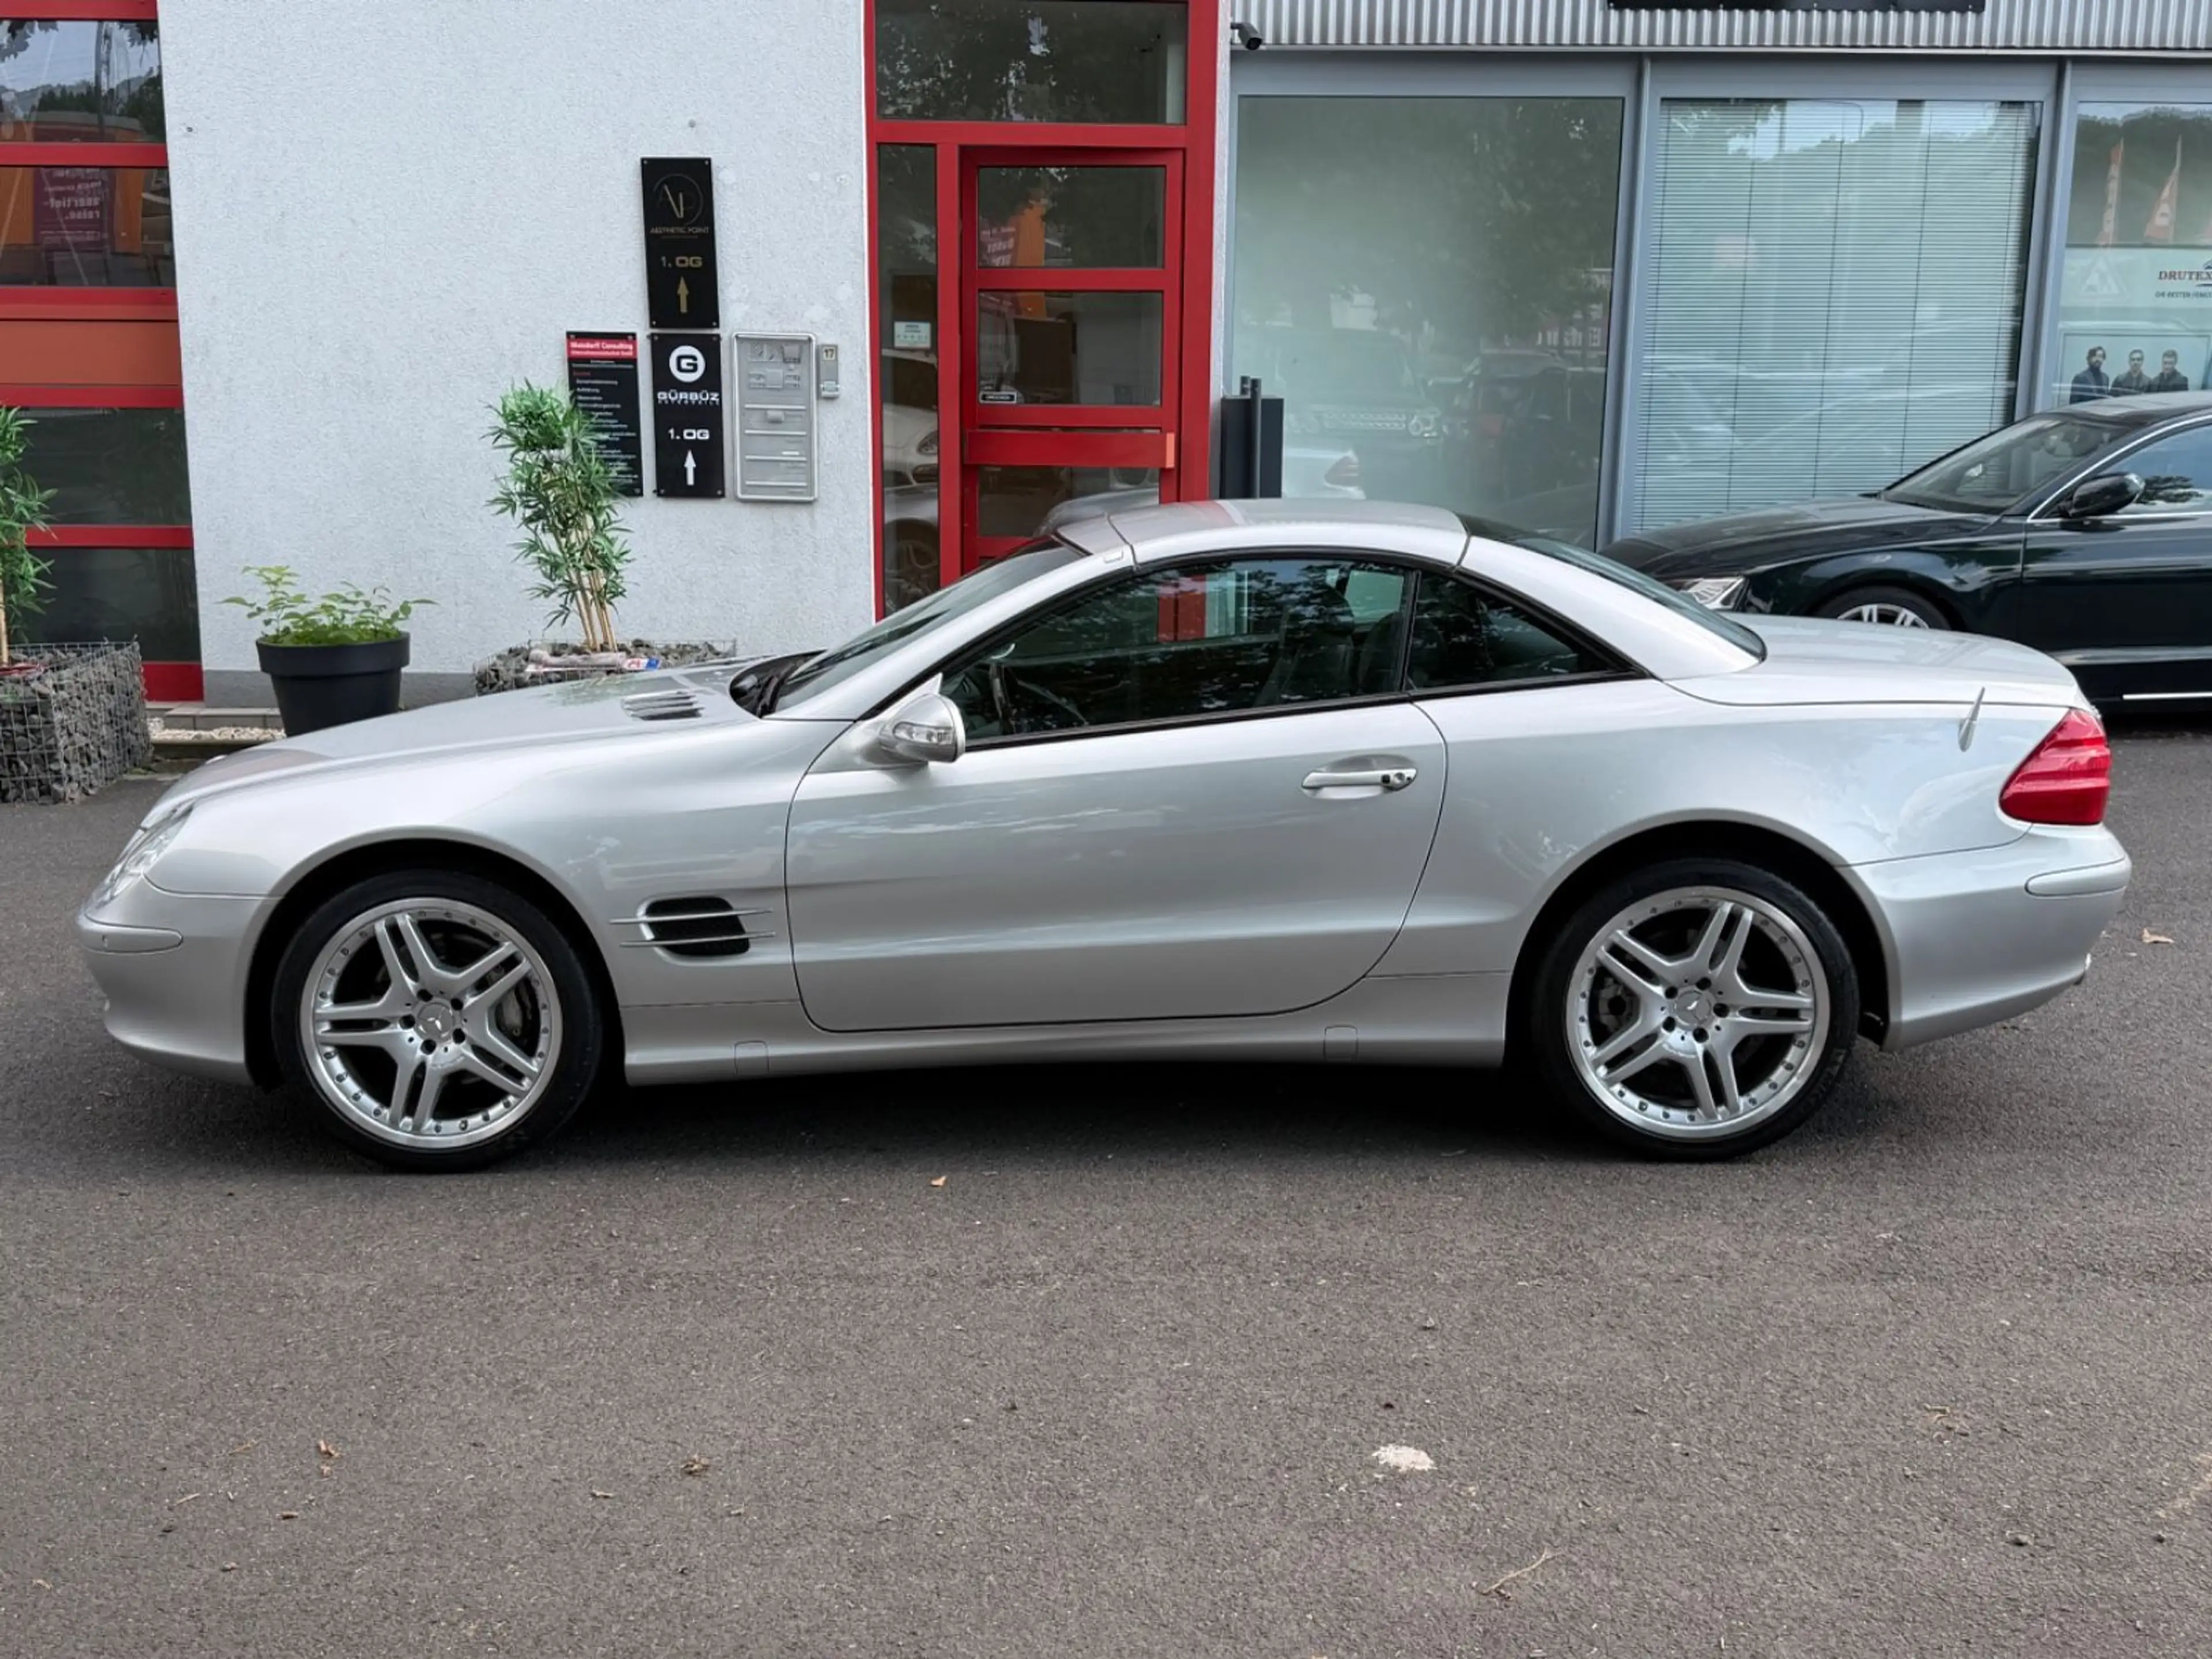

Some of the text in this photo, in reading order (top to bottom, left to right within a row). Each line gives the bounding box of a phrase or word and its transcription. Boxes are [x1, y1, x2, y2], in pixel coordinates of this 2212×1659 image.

[661, 256, 703, 267] 1. OG
[823, 349, 835, 359] 17
[677, 355, 698, 373] G
[657, 389, 720, 401] GÜRBÜZ
[668, 428, 710, 440] 1. OG
